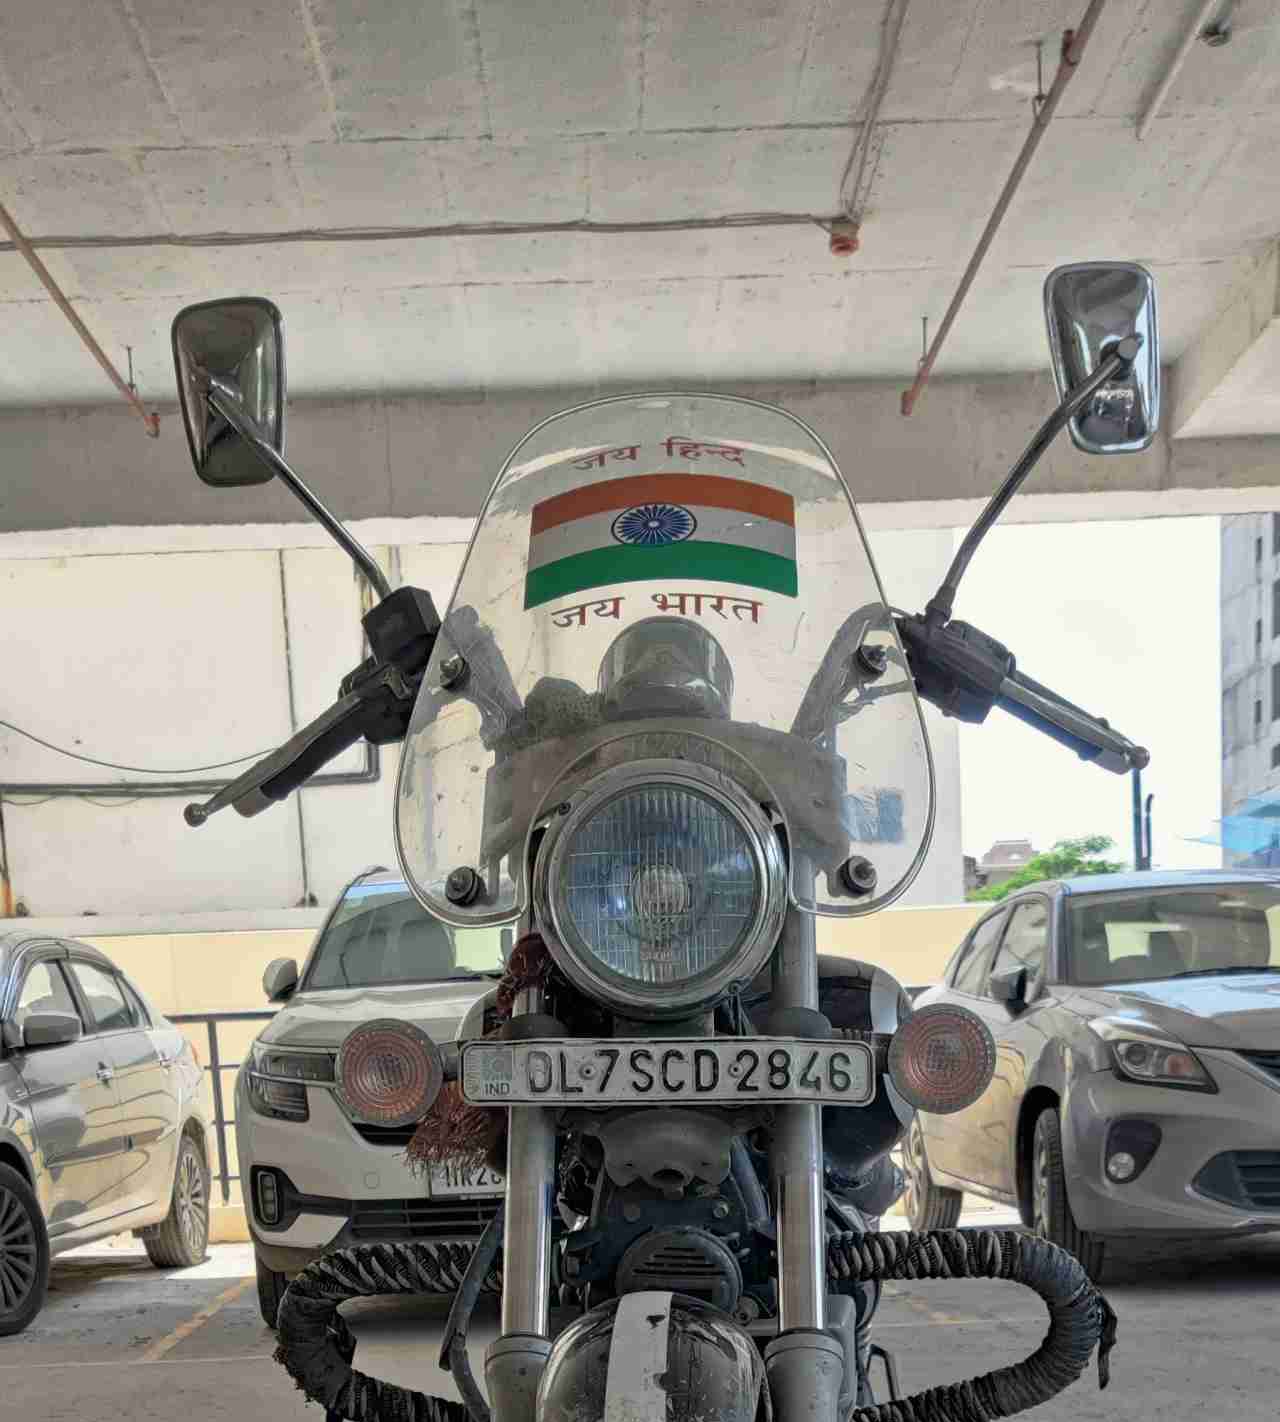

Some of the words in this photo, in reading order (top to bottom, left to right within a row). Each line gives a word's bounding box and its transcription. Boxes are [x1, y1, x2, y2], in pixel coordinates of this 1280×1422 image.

[571, 444, 641, 471] जय
[660, 436, 745, 467] हिन्द
[551, 596, 626, 628] जय
[651, 593, 763, 624] भारत
[484, 1082, 511, 1097] IND
